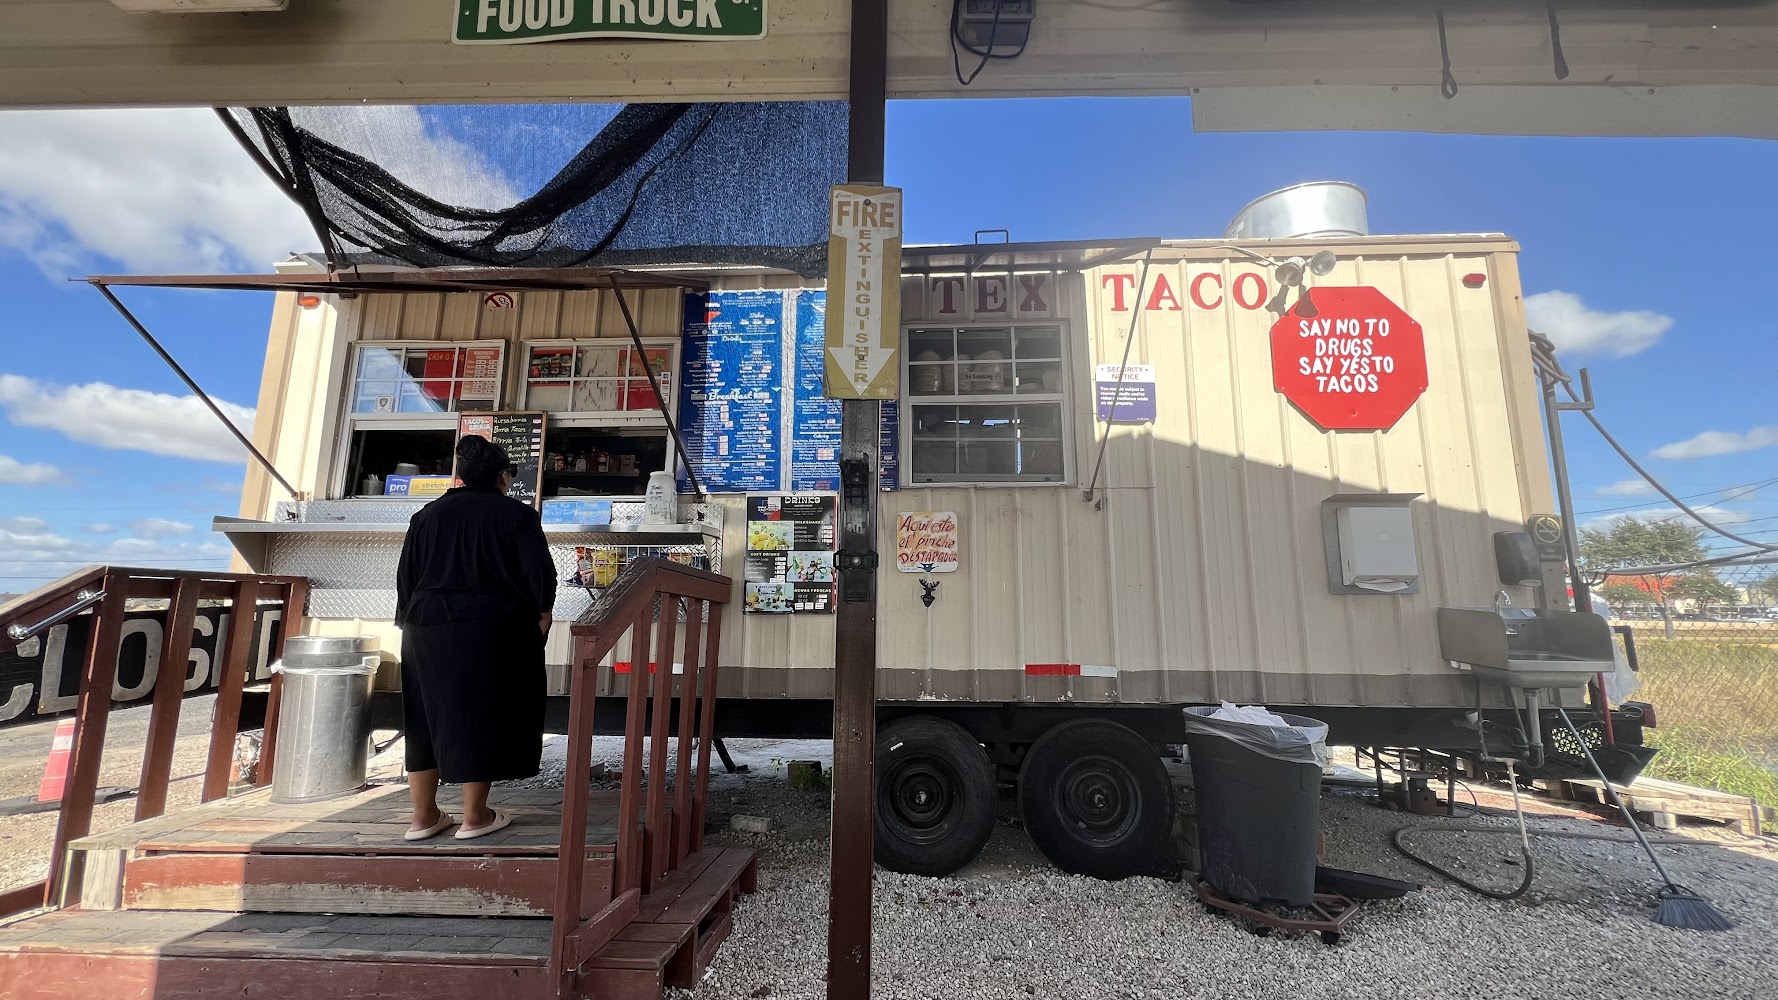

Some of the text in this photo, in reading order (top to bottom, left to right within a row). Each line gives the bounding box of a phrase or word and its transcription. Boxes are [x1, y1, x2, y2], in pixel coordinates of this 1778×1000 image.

[476, 0, 723, 33] FOOD TRUCK
[837, 200, 895, 229] FIRE
[932, 272, 1268, 313] TEX TACO
[854, 229, 873, 384] EXTINGUISHER
[1299, 318, 1390, 338] SAY NO TO
[1315, 337, 1373, 358] DRUGS
[1299, 356, 1394, 375] SAY YES TO
[1315, 374, 1379, 393] TACOS
[463, 418, 485, 426] TACOS
[389, 483, 407, 492] pro
[784, 496, 821, 504] DRINKS
[915, 534, 955, 551] pinche
